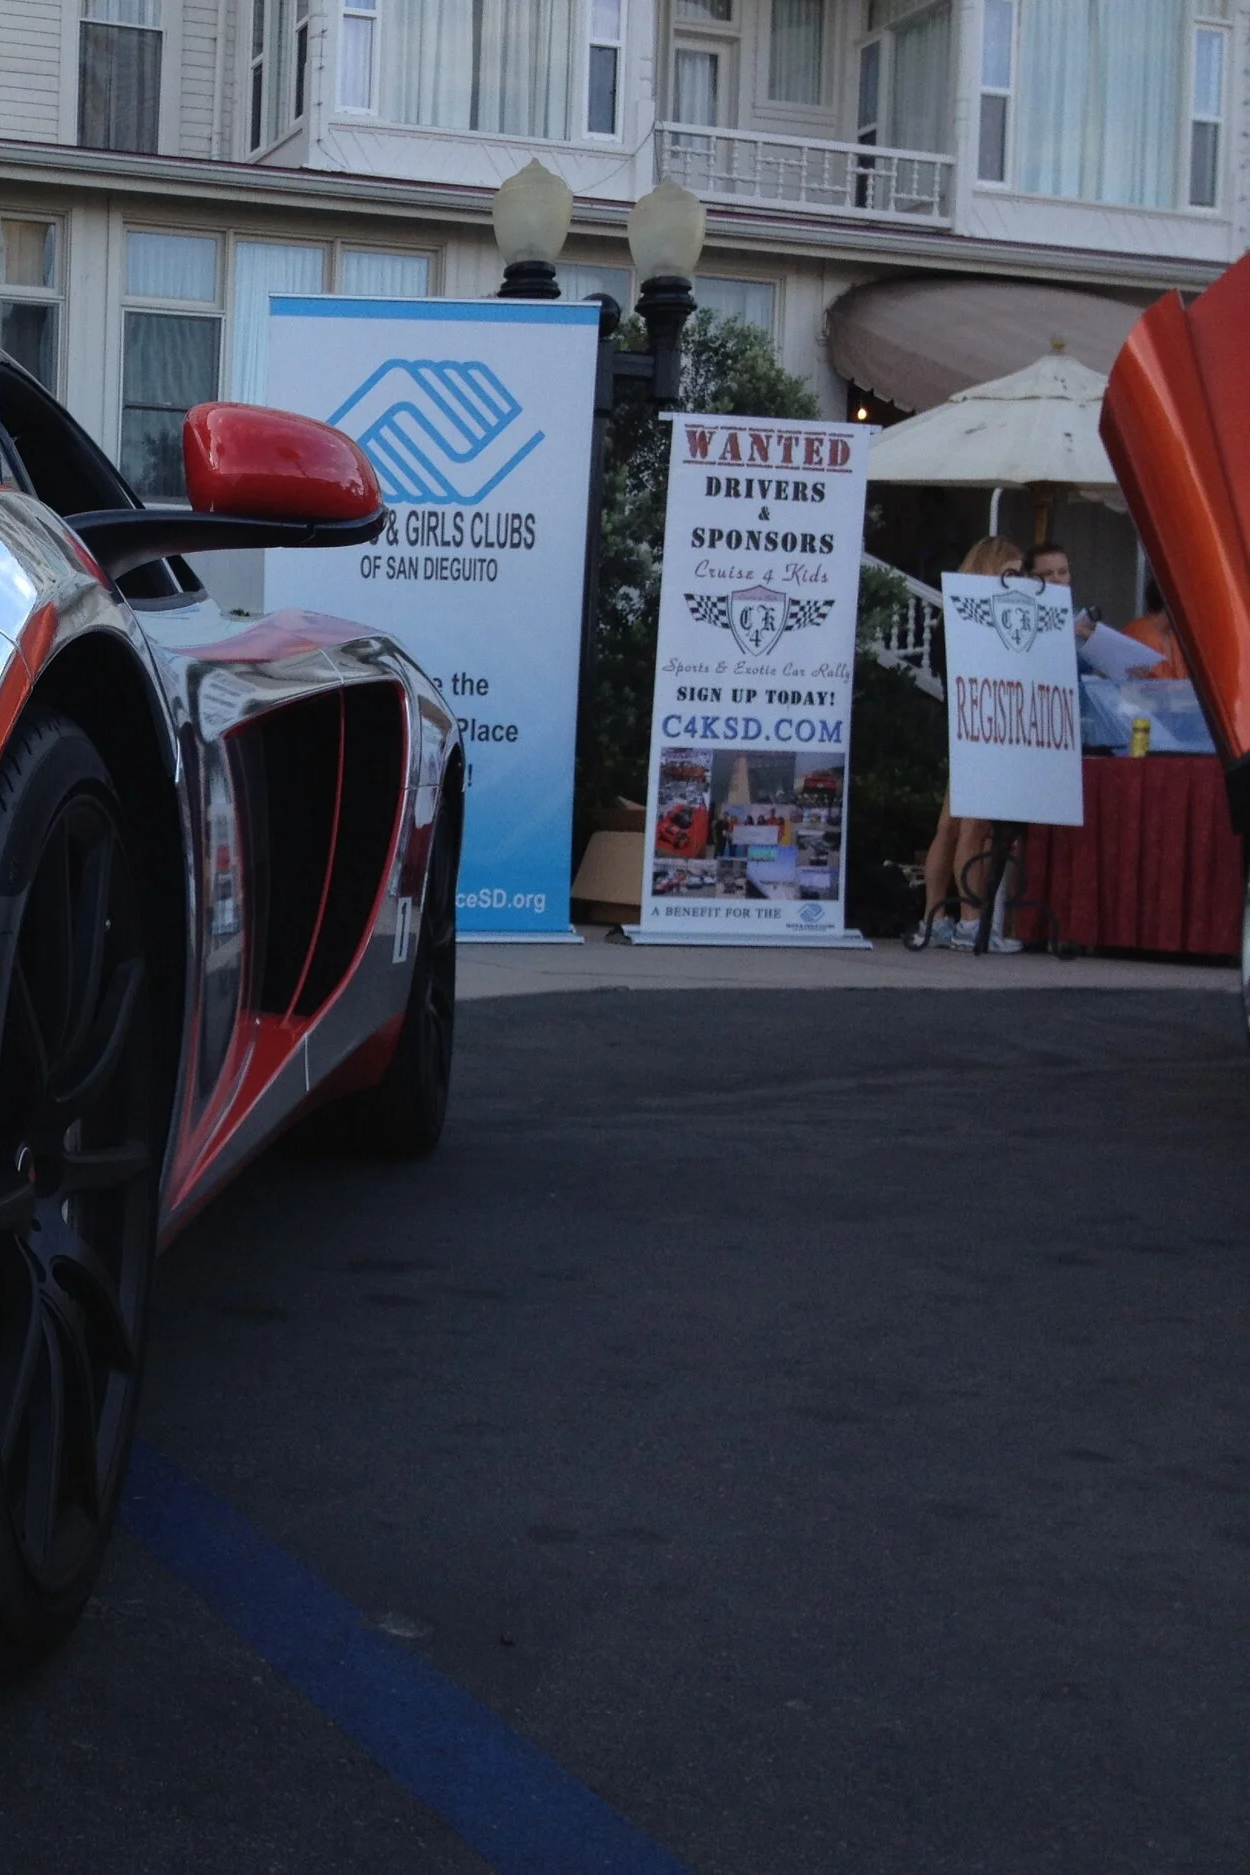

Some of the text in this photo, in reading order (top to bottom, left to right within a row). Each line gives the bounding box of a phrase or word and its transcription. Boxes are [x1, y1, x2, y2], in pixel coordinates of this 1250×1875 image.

[685, 429, 851, 467] WANTED
[705, 476, 826, 503] DRIVERS
[758, 506, 770, 521] &
[406, 510, 464, 548] GIRLS
[470, 512, 536, 550] CLUBS
[691, 527, 834, 554] SPONSORS
[360, 555, 498, 582] OF SAN DIEGUITO
[695, 559, 754, 579] Cruise
[782, 563, 828, 586] Kids
[452, 672, 489, 696] the
[662, 658, 709, 676] Sports
[782, 662, 805, 677] Car
[811, 663, 850, 684] Rally
[676, 686, 835, 706] SIGN UP TODAY!
[956, 676, 1075, 751] REGISTRATION
[457, 718, 518, 742] Place
[661, 714, 843, 744] C4KSD.COM
[651, 906, 782, 920] A BENEFIT FOR THE
